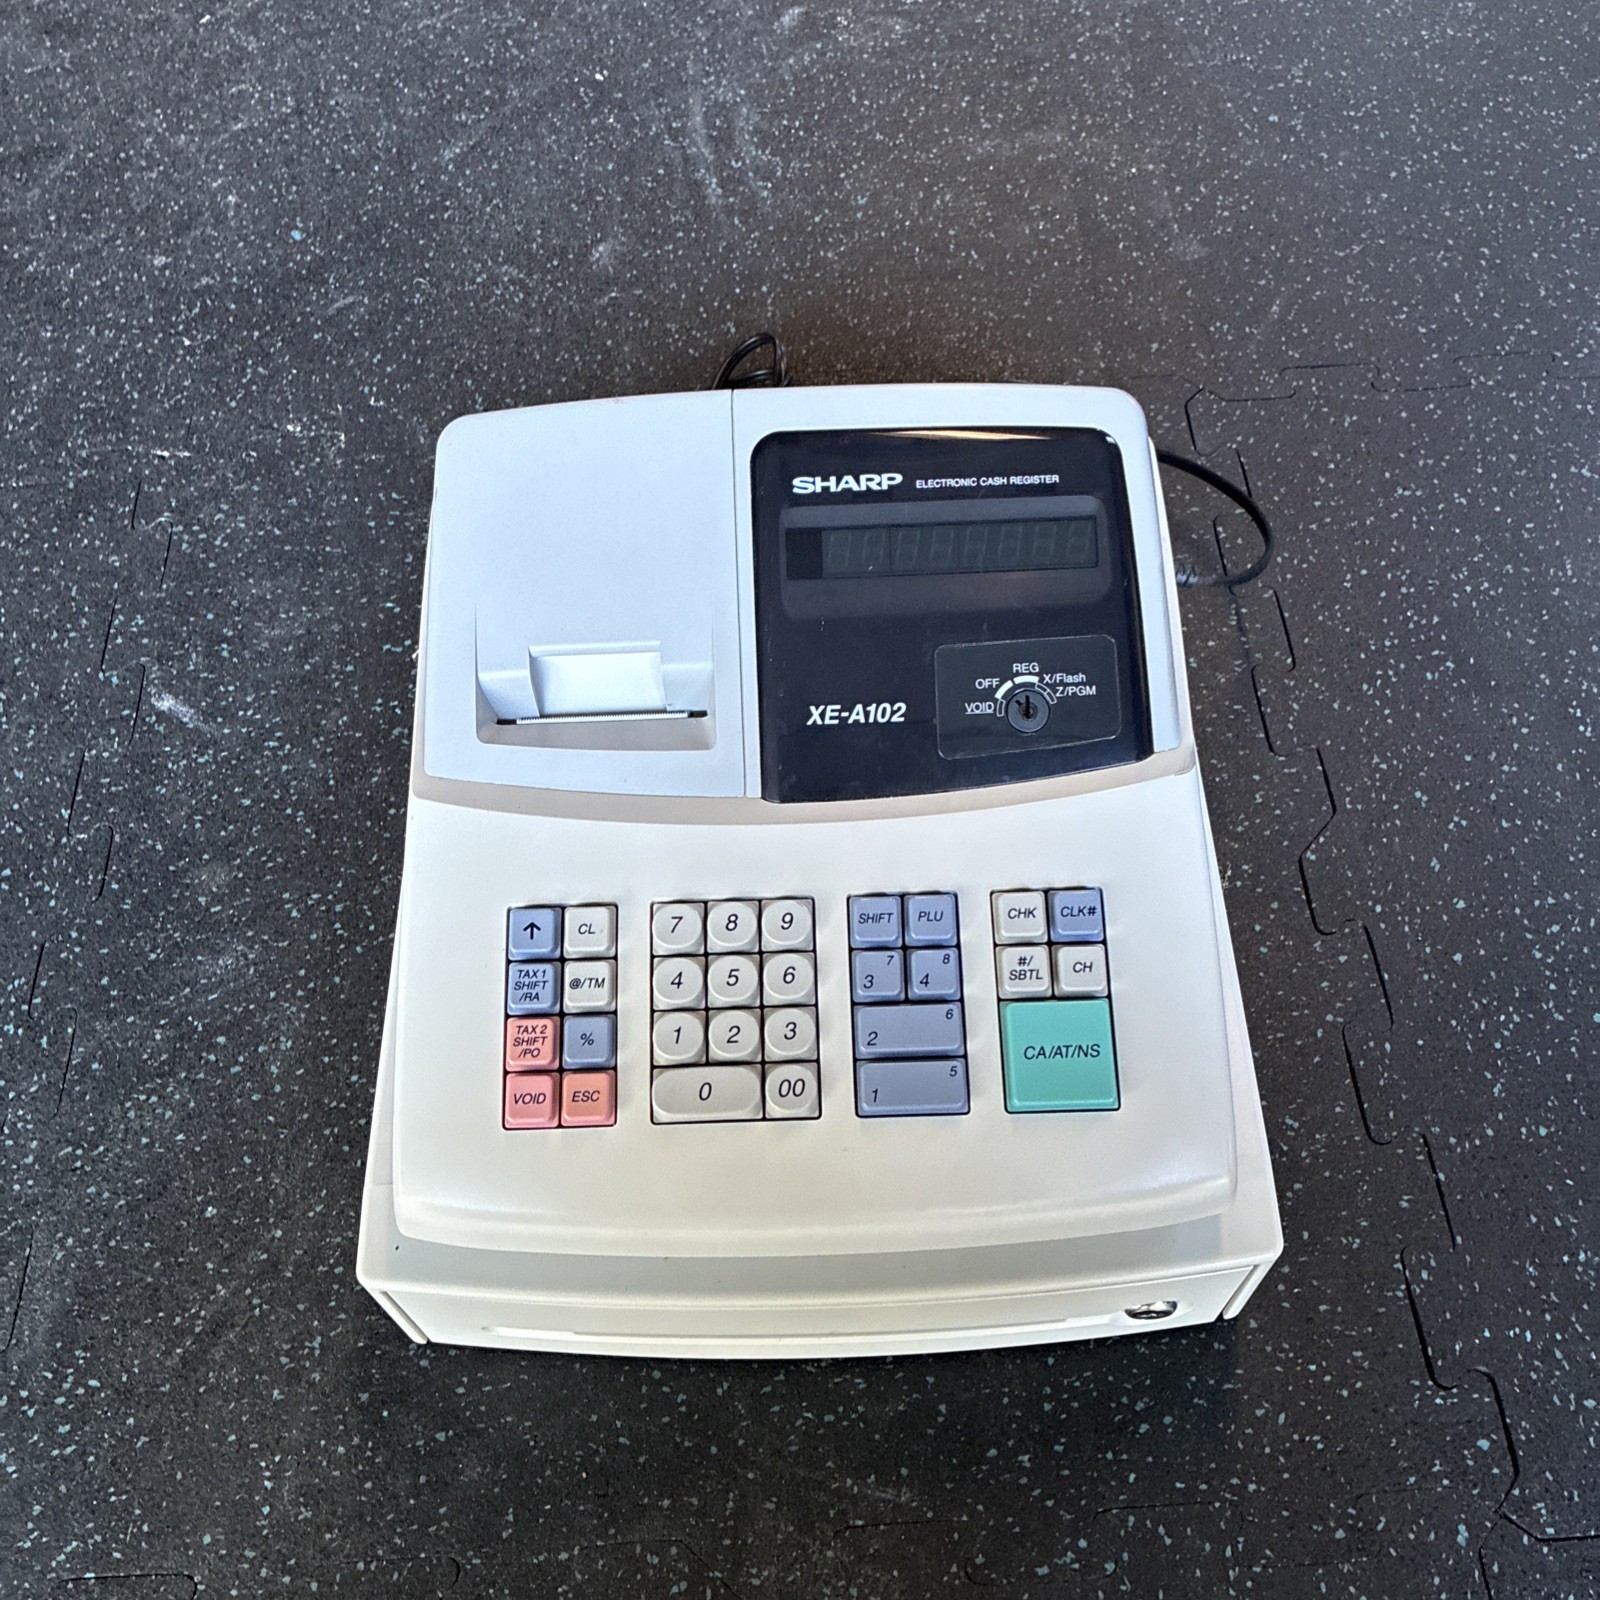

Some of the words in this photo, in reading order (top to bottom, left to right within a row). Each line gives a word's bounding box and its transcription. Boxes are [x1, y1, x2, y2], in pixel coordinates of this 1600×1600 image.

[792, 473, 903, 494] SHARP
[916, 478, 977, 489] ELECTRONIC
[980, 476, 1007, 486] CASH
[1009, 475, 1059, 485] REGISTER
[1013, 663, 1039, 673] REG
[975, 678, 1000, 689] OFF
[1043, 673, 1086, 684] X/Flash
[1056, 686, 1096, 697] Z/PGM
[965, 702, 994, 714] VOID
[806, 702, 906, 726] XE-A102
[918, 911, 943, 922] PLU
[1008, 908, 1036, 919] CHK
[1060, 906, 1097, 917] CLK#
[726, 914, 738, 931] 8
[781, 913, 793, 930] 9
[858, 913, 893, 924] SHIFT
[578, 924, 595, 934] CL
[670, 916, 683, 933] 7
[887, 955, 894, 965] 7
[942, 954, 950, 964] 8
[1018, 956, 1033, 966] #/
[1073, 962, 1093, 973] CH
[517, 970, 539, 979] TAX
[541, 970, 546, 979] 1
[726, 969, 740, 986] 5
[783, 966, 795, 984] 6
[1009, 969, 1043, 981] SBTL
[514, 980, 548, 990] SHIFT
[569, 978, 605, 989] @/TM
[671, 972, 683, 989] 4
[863, 975, 874, 989] 3
[920, 974, 930, 987] 4
[519, 992, 540, 1002] /RA
[946, 1009, 953, 1019] 6
[516, 1025, 538, 1034] TAX
[540, 1025, 547, 1034] 2
[726, 1026, 740, 1043] 2
[784, 1022, 797, 1040] 3
[513, 1036, 548, 1046] SHIFT
[581, 1033, 594, 1046] %
[674, 1027, 681, 1044] 1
[867, 1031, 878, 1046] 2
[518, 1048, 540, 1058] /PO
[1024, 1044, 1100, 1060] CA/AT/NS
[950, 1066, 957, 1077] 5
[699, 1083, 712, 1101] 0
[778, 1079, 805, 1097] 00
[514, 1093, 546, 1105] VOID
[572, 1091, 600, 1102] ESC
[872, 1089, 878, 1102] 1
